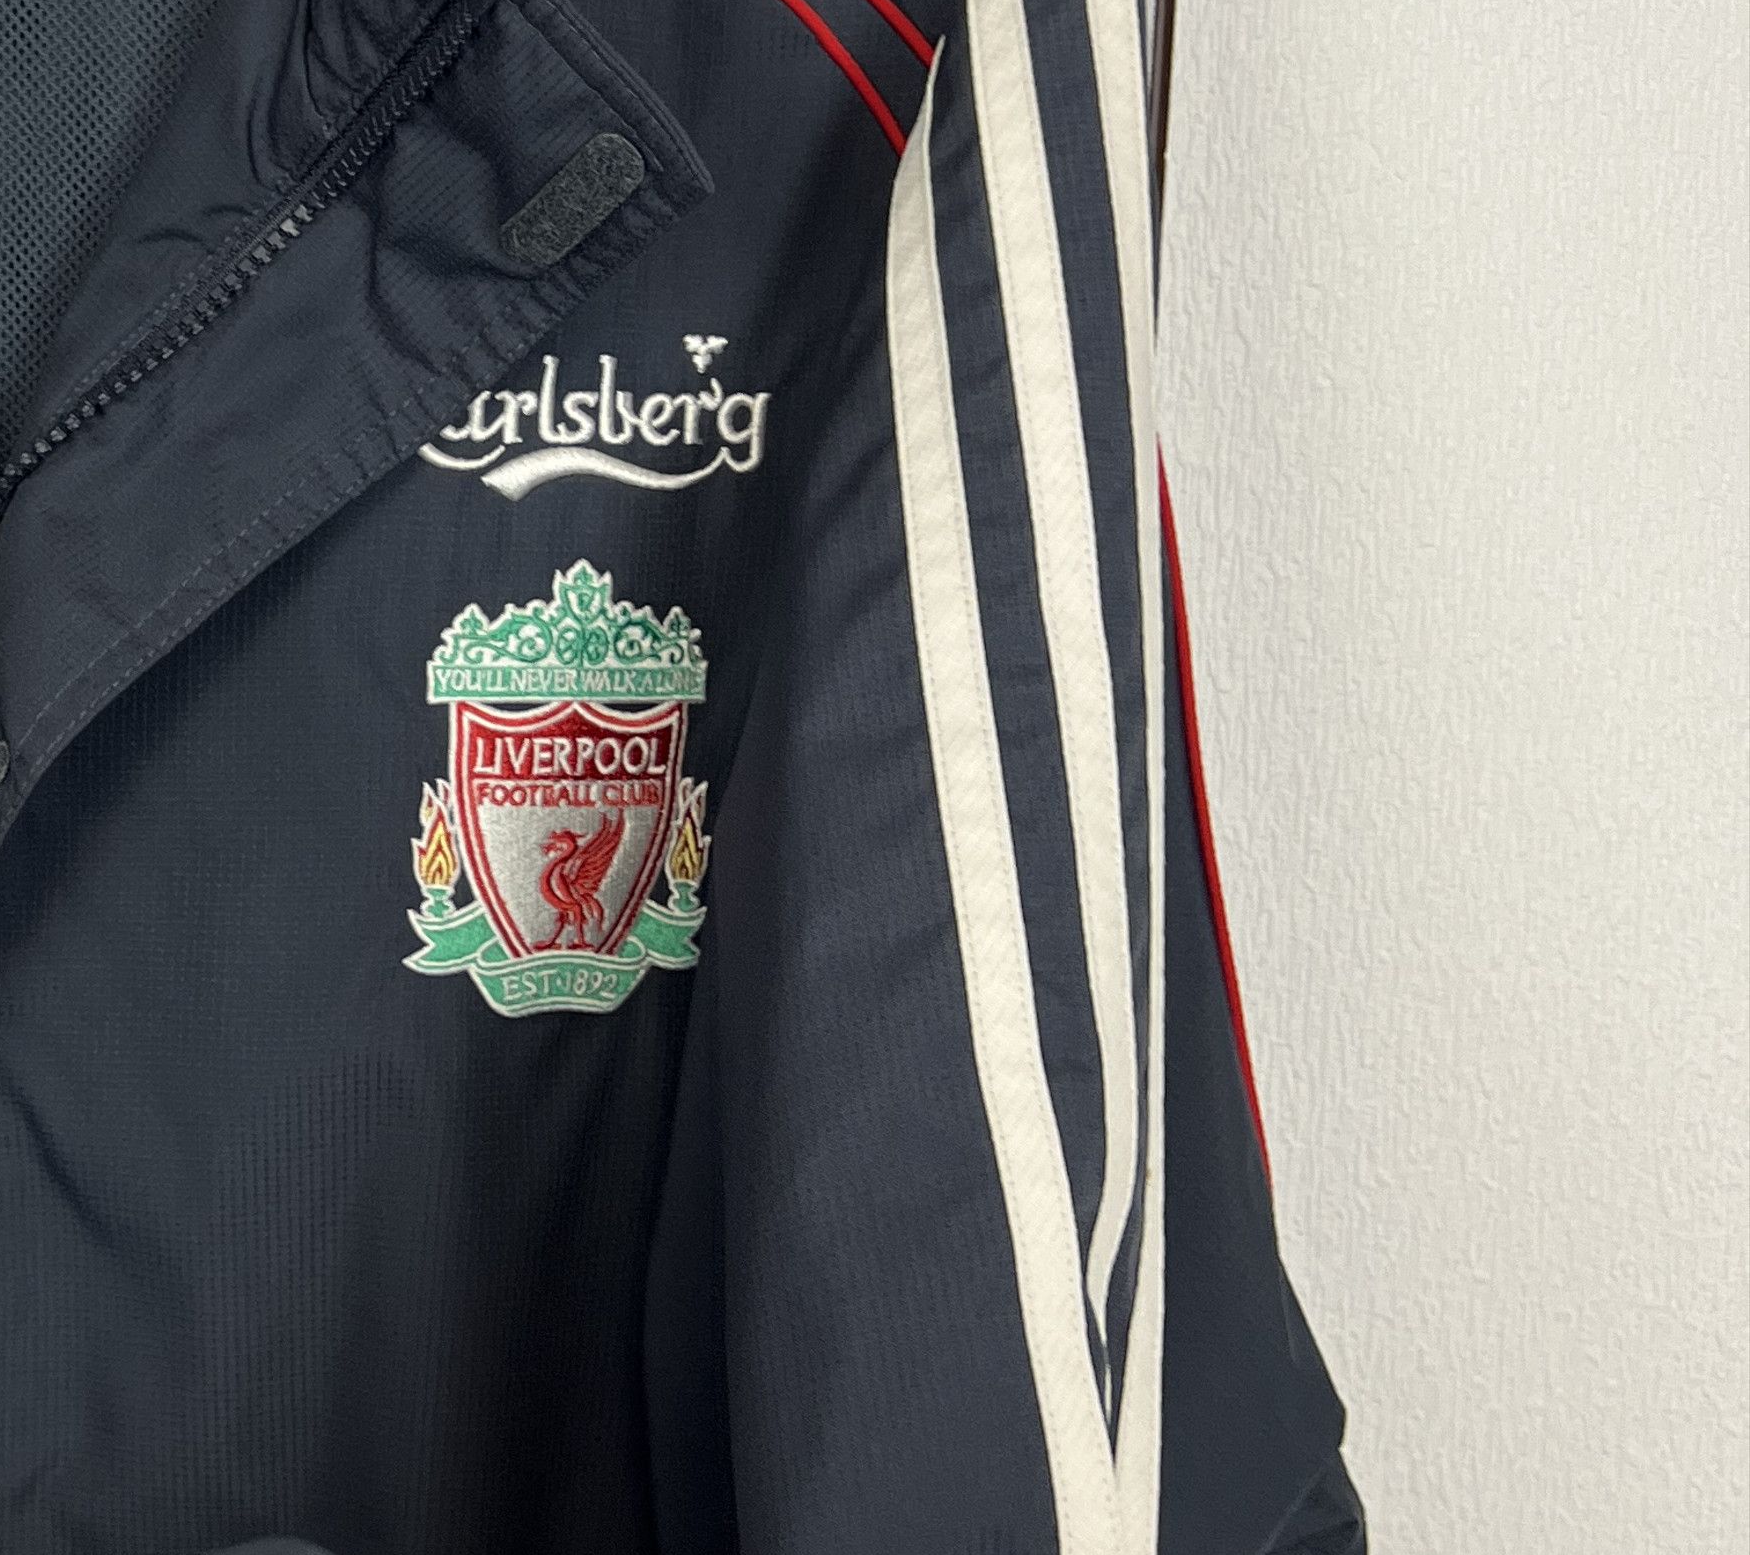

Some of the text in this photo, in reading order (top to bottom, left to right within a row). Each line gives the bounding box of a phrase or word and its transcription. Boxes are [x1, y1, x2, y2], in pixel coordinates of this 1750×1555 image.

[418, 352, 772, 500] arlsberg
[510, 668, 578, 693] NEVER
[580, 669, 636, 693] WALK
[473, 737, 666, 775] LIVERPOOL
[477, 783, 661, 807] FOOTBALL CLUB
